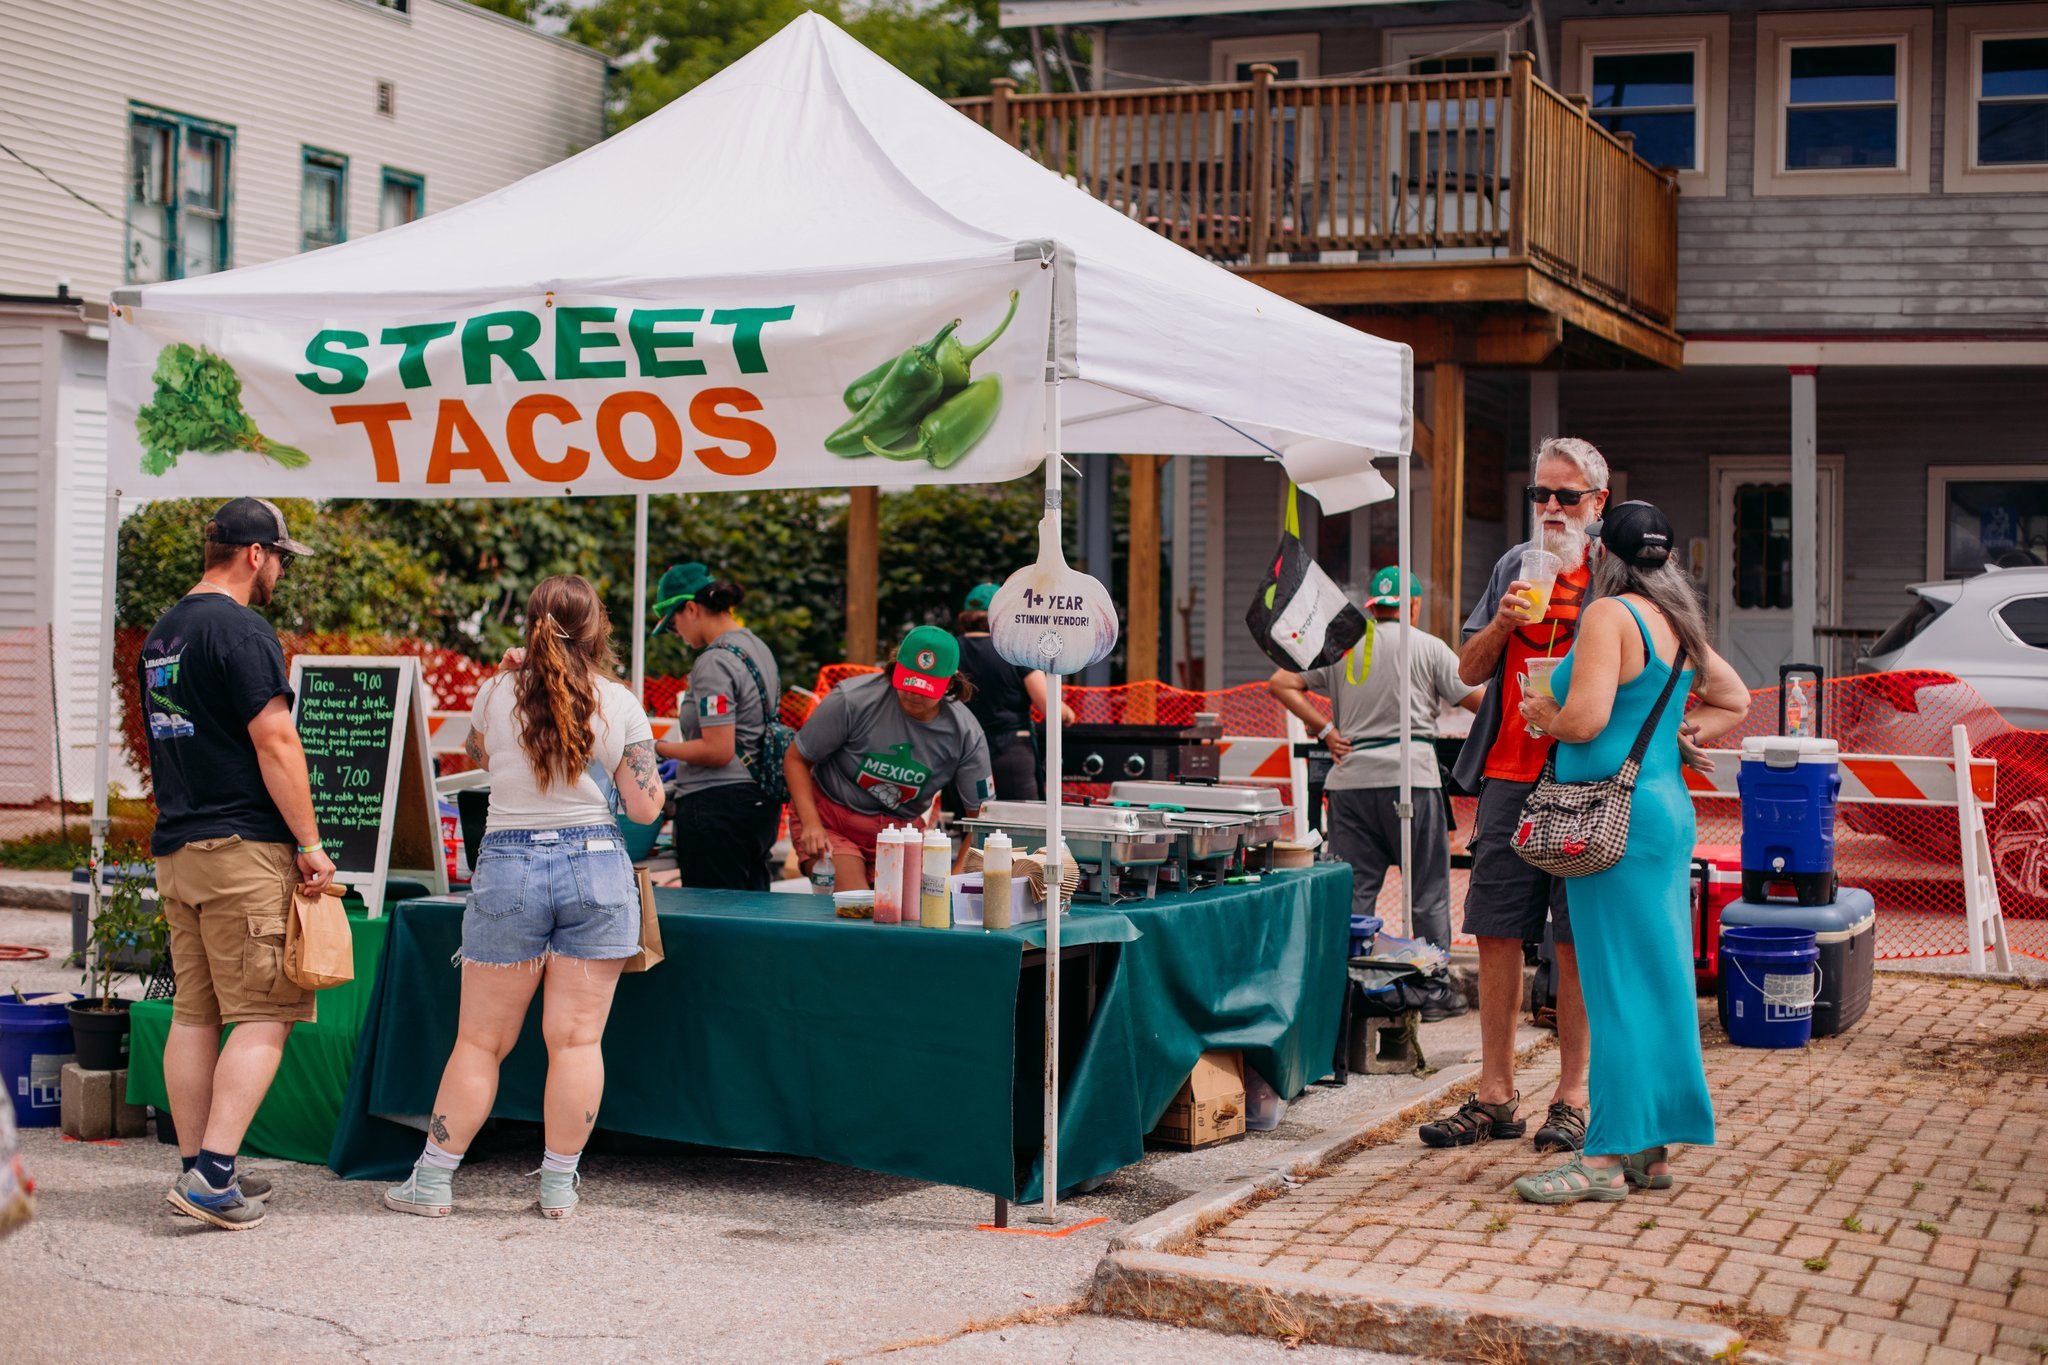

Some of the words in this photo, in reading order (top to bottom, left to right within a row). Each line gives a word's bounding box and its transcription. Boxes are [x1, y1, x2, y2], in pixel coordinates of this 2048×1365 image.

[295, 305, 795, 394] STREET
[329, 387, 777, 484] TACOS
[1023, 588, 1044, 608] 1+
[1048, 595, 1084, 610] YEAR
[1015, 614, 1051, 625] STINKIN'
[1053, 615, 1090, 627] VENDOR!
[349, 695, 358, 709] of
[304, 708, 334, 720] chicken
[336, 712, 344, 720] or
[372, 726, 386, 736] and
[864, 757, 926, 784] MEXICO
